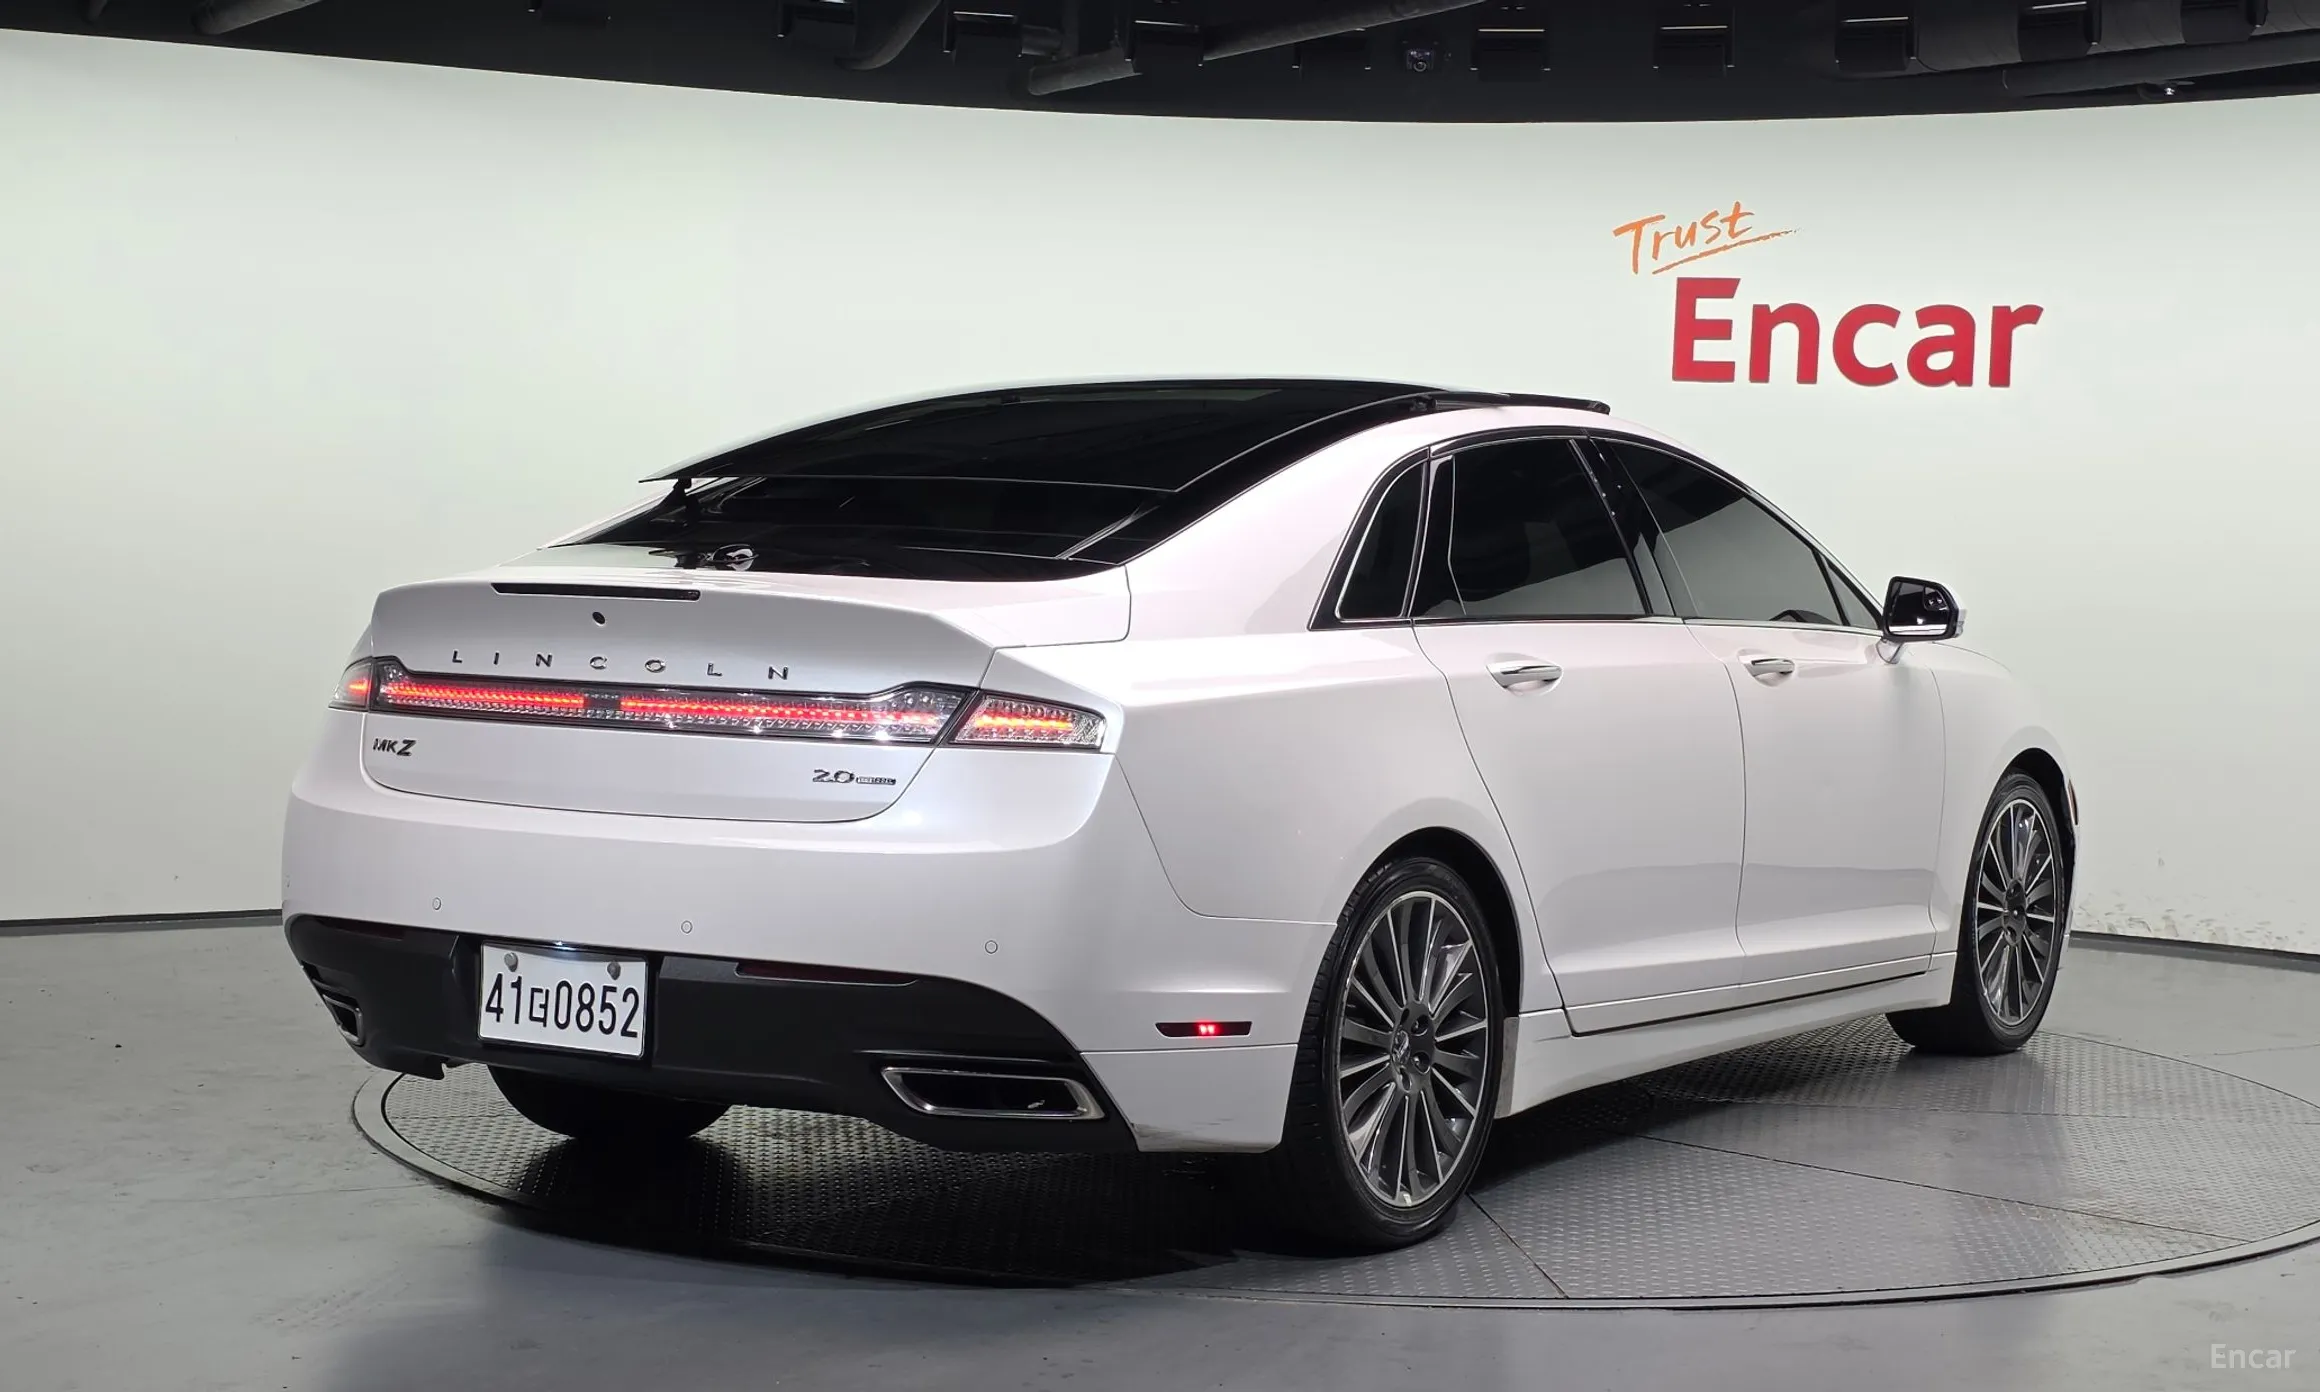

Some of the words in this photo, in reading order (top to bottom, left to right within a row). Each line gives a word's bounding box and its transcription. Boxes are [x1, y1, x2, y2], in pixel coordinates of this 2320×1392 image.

[1612, 201, 1756, 275] Trust
[1672, 277, 2044, 388] Encar
[451, 650, 789, 681] LINCOLN
